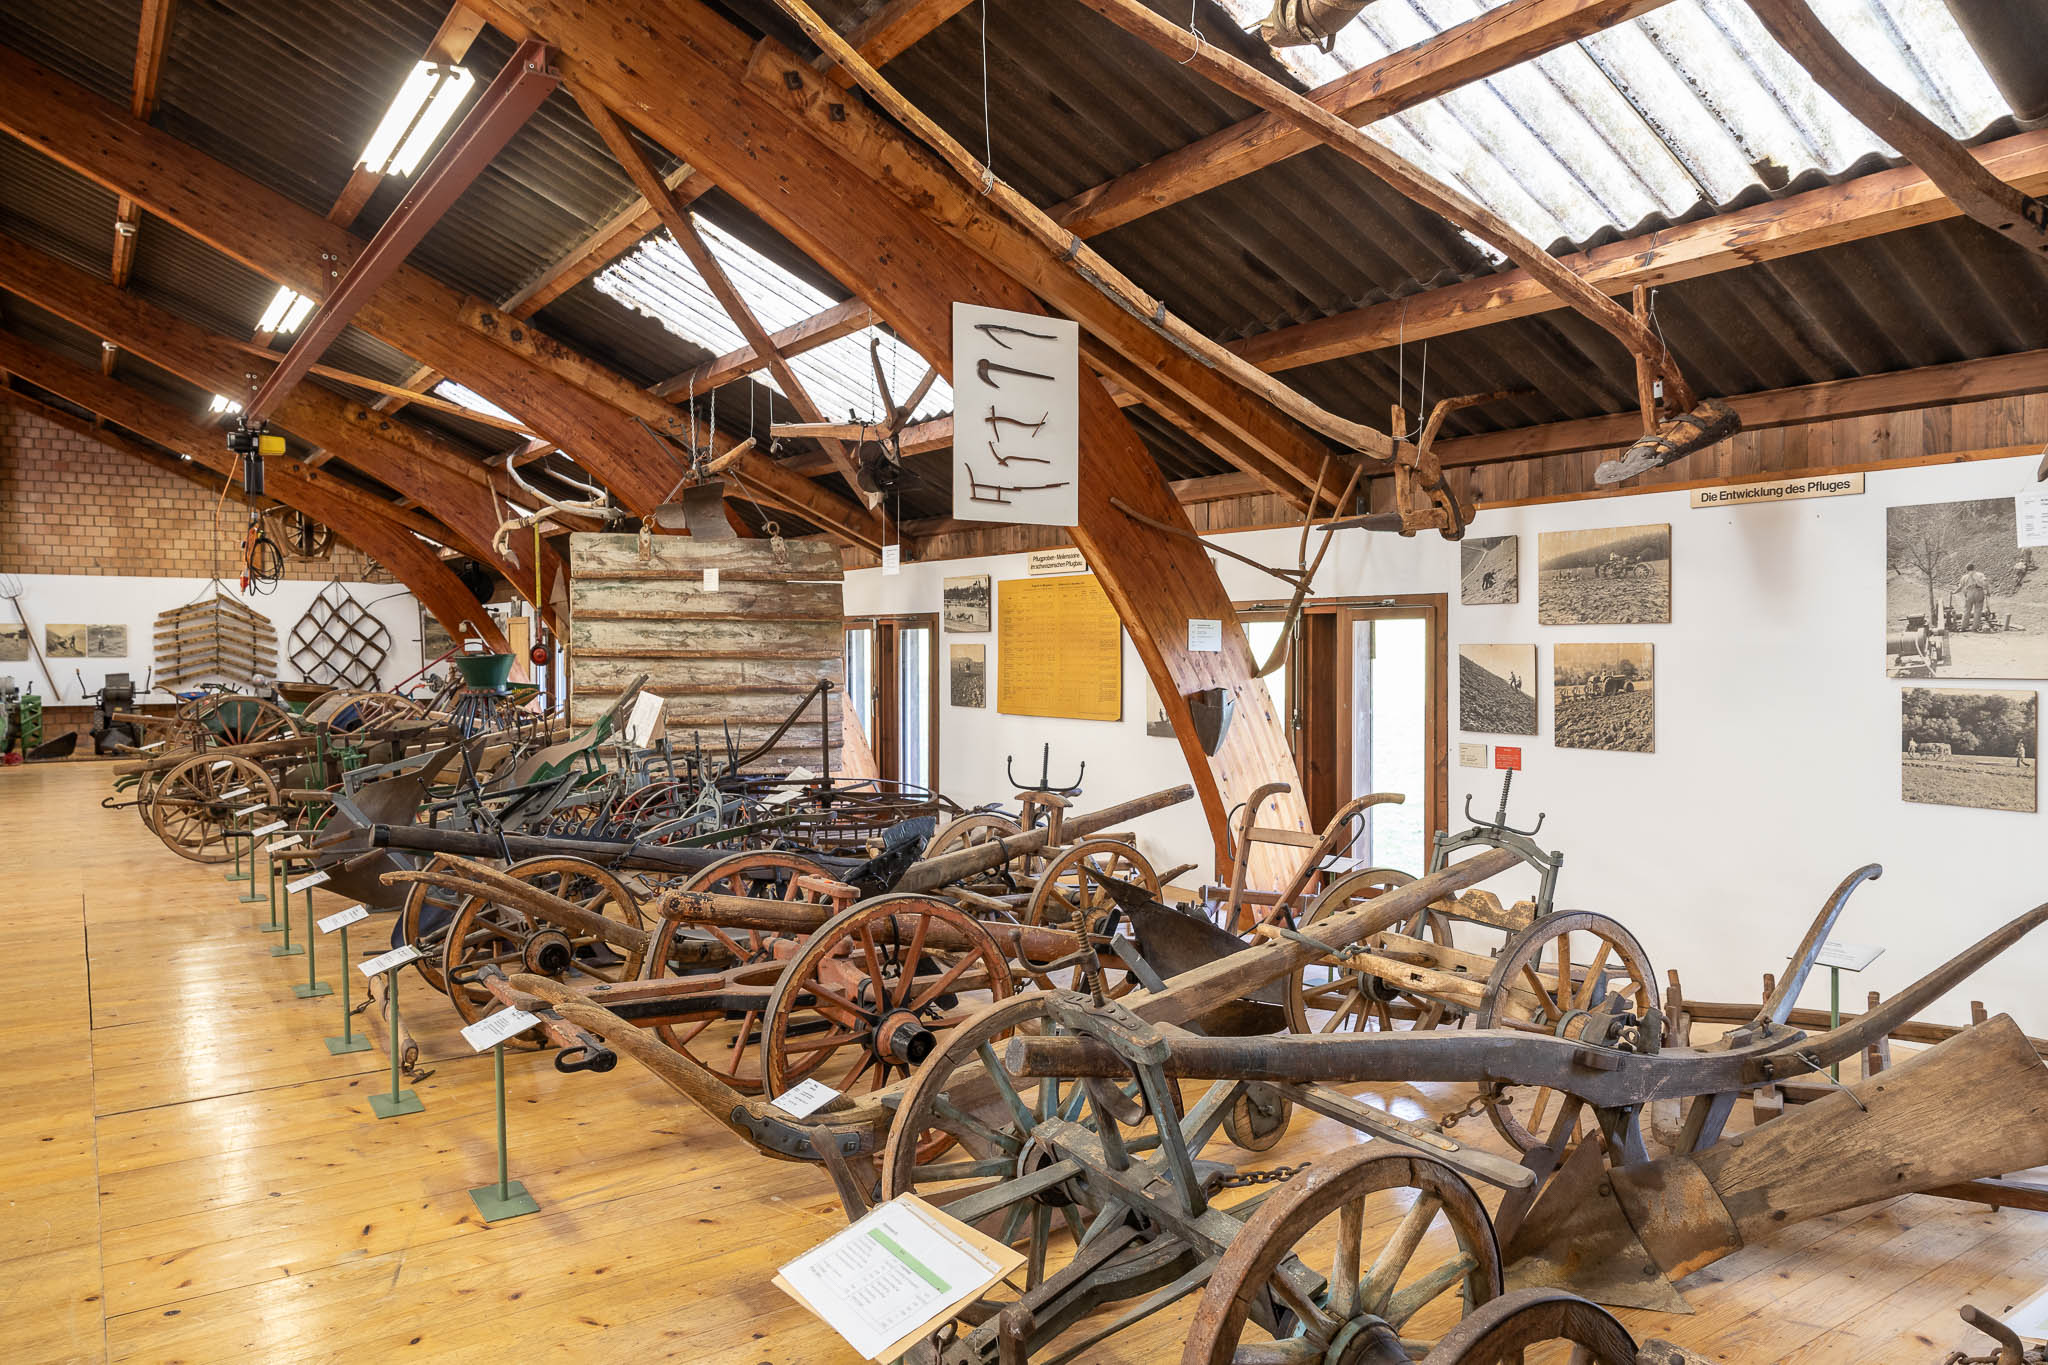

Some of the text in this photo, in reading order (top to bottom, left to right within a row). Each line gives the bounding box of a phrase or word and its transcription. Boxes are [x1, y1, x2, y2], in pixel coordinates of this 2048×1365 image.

[1701, 480, 1851, 503] Die Entwicklung des Pfluges
